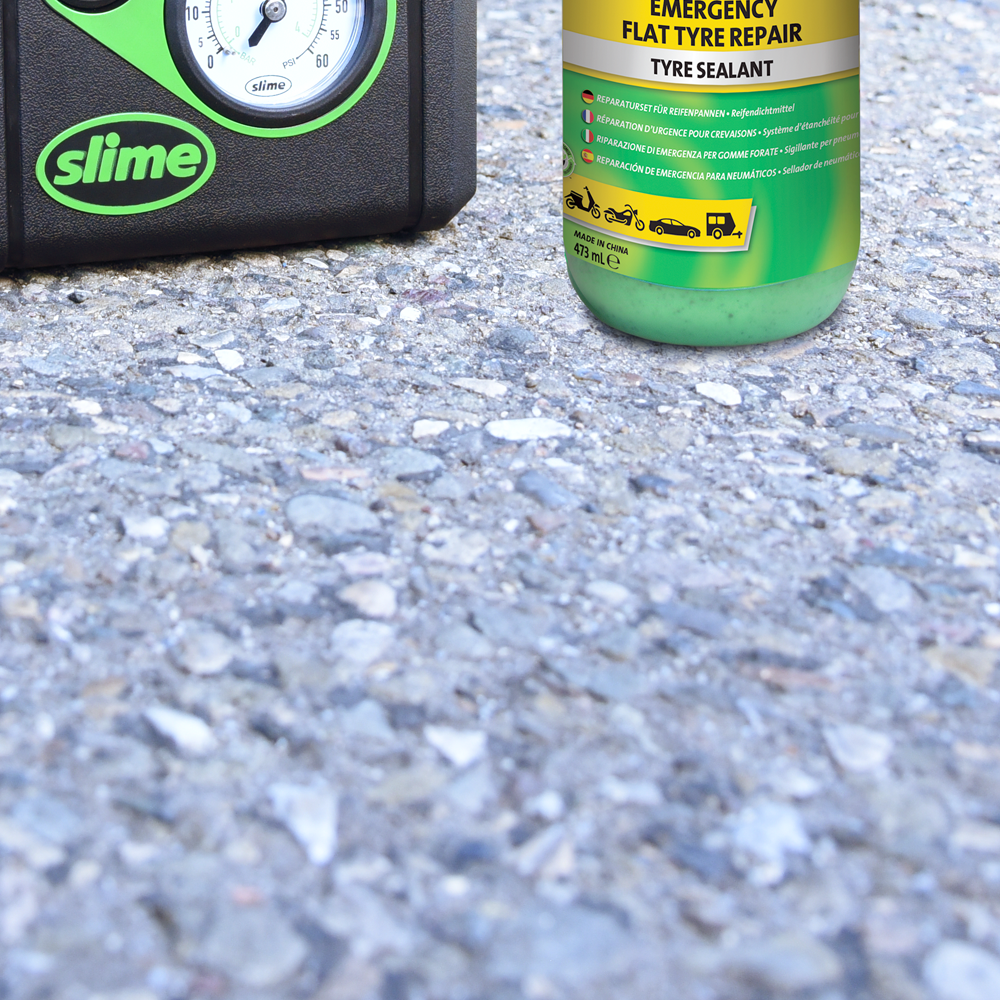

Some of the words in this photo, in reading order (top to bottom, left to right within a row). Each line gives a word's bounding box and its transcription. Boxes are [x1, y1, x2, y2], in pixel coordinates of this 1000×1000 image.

[186, 6, 199, 21] 10
[335, 0, 348, 14] 50
[330, 29, 340, 41] 55
[622, 20, 670, 43] FLAT
[674, 25, 725, 47] TYRE
[730, 23, 803, 47] REPAIR
[240, 52, 257, 66] BAR
[282, 57, 297, 70] PSI
[316, 53, 329, 68] 60
[650, 58, 693, 78] TYRE
[697, 59, 774, 79] SEALANT
[251, 80, 287, 92] slime
[596, 94, 653, 112] REPARATURSET
[653, 104, 668, 115] FÜR
[669, 107, 726, 118] REIFENPANNEN
[731, 103, 796, 119] Reifendichtmittel
[596, 114, 644, 132] RÉPARATION
[644, 125, 688, 137] D'URGENCE
[688, 129, 710, 139] POUR
[710, 128, 757, 139] CREVAISONS
[762, 125, 794, 138] Système
[596, 134, 646, 153] RIPARAZIONE
[646, 146, 656, 155] DI
[656, 147, 702, 159] EMERGENZA
[703, 150, 718, 160] PER
[717, 149, 749, 160] GOMME
[749, 147, 779, 158] FORATE
[784, 141, 819, 156] Sigillante
[819, 138, 833, 150] per
[832, 131, 859, 146] pneum
[53, 131, 202, 187] slime
[596, 155, 644, 174] REPARACIÓN
[644, 166, 656, 176] DE
[656, 167, 705, 180] EMERGENCIA
[705, 171, 726, 181] PARA
[726, 168, 777, 181] NEUMÁTICOS
[782, 162, 814, 175] Sellador
[813, 159, 824, 170] de
[573, 230, 596, 245] MADE
[596, 239, 606, 248] IN
[606, 242, 629, 256] CHINA
[573, 242, 590, 259] 473
[591, 251, 606, 266] mL
